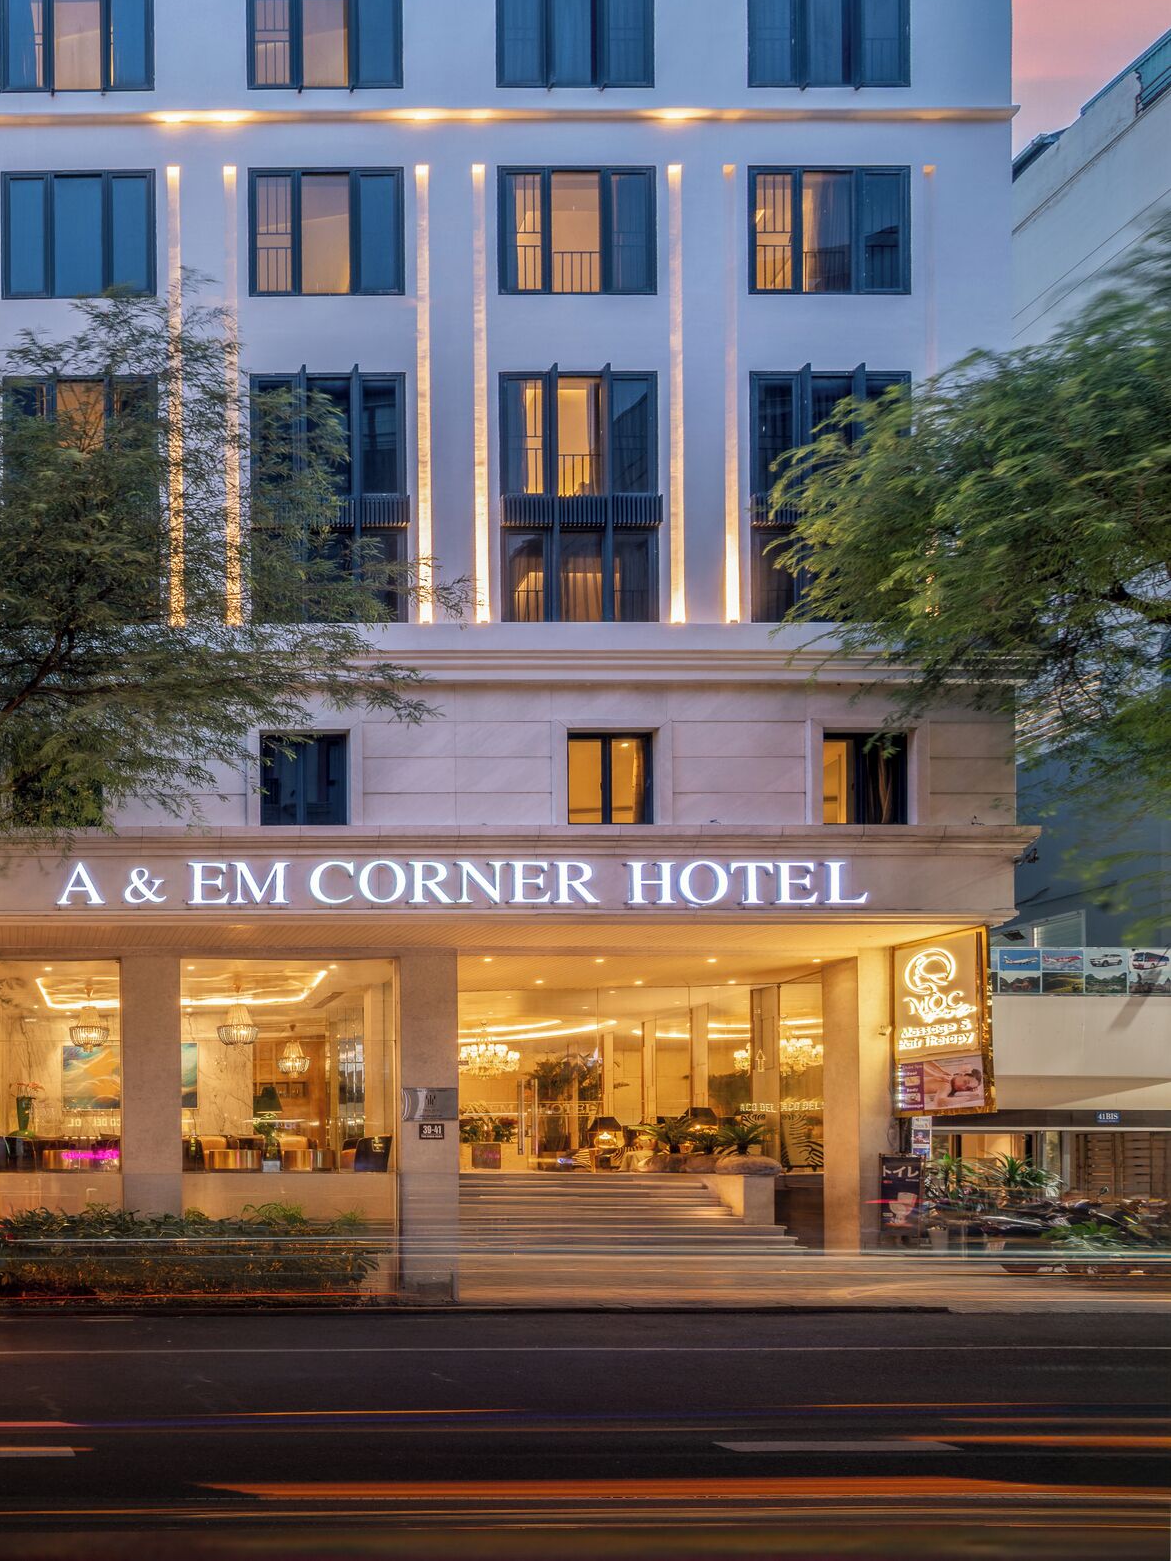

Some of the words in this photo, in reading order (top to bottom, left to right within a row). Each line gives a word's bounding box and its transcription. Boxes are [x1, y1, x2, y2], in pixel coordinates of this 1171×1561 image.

[57, 861, 106, 906] A
[123, 867, 168, 905] &
[187, 861, 291, 906] EM
[309, 859, 601, 906] CORNER
[626, 859, 869, 906] HOTEL
[422, 1125, 442, 1134] 39-41
[882, 1165, 919, 1178] トイレ
